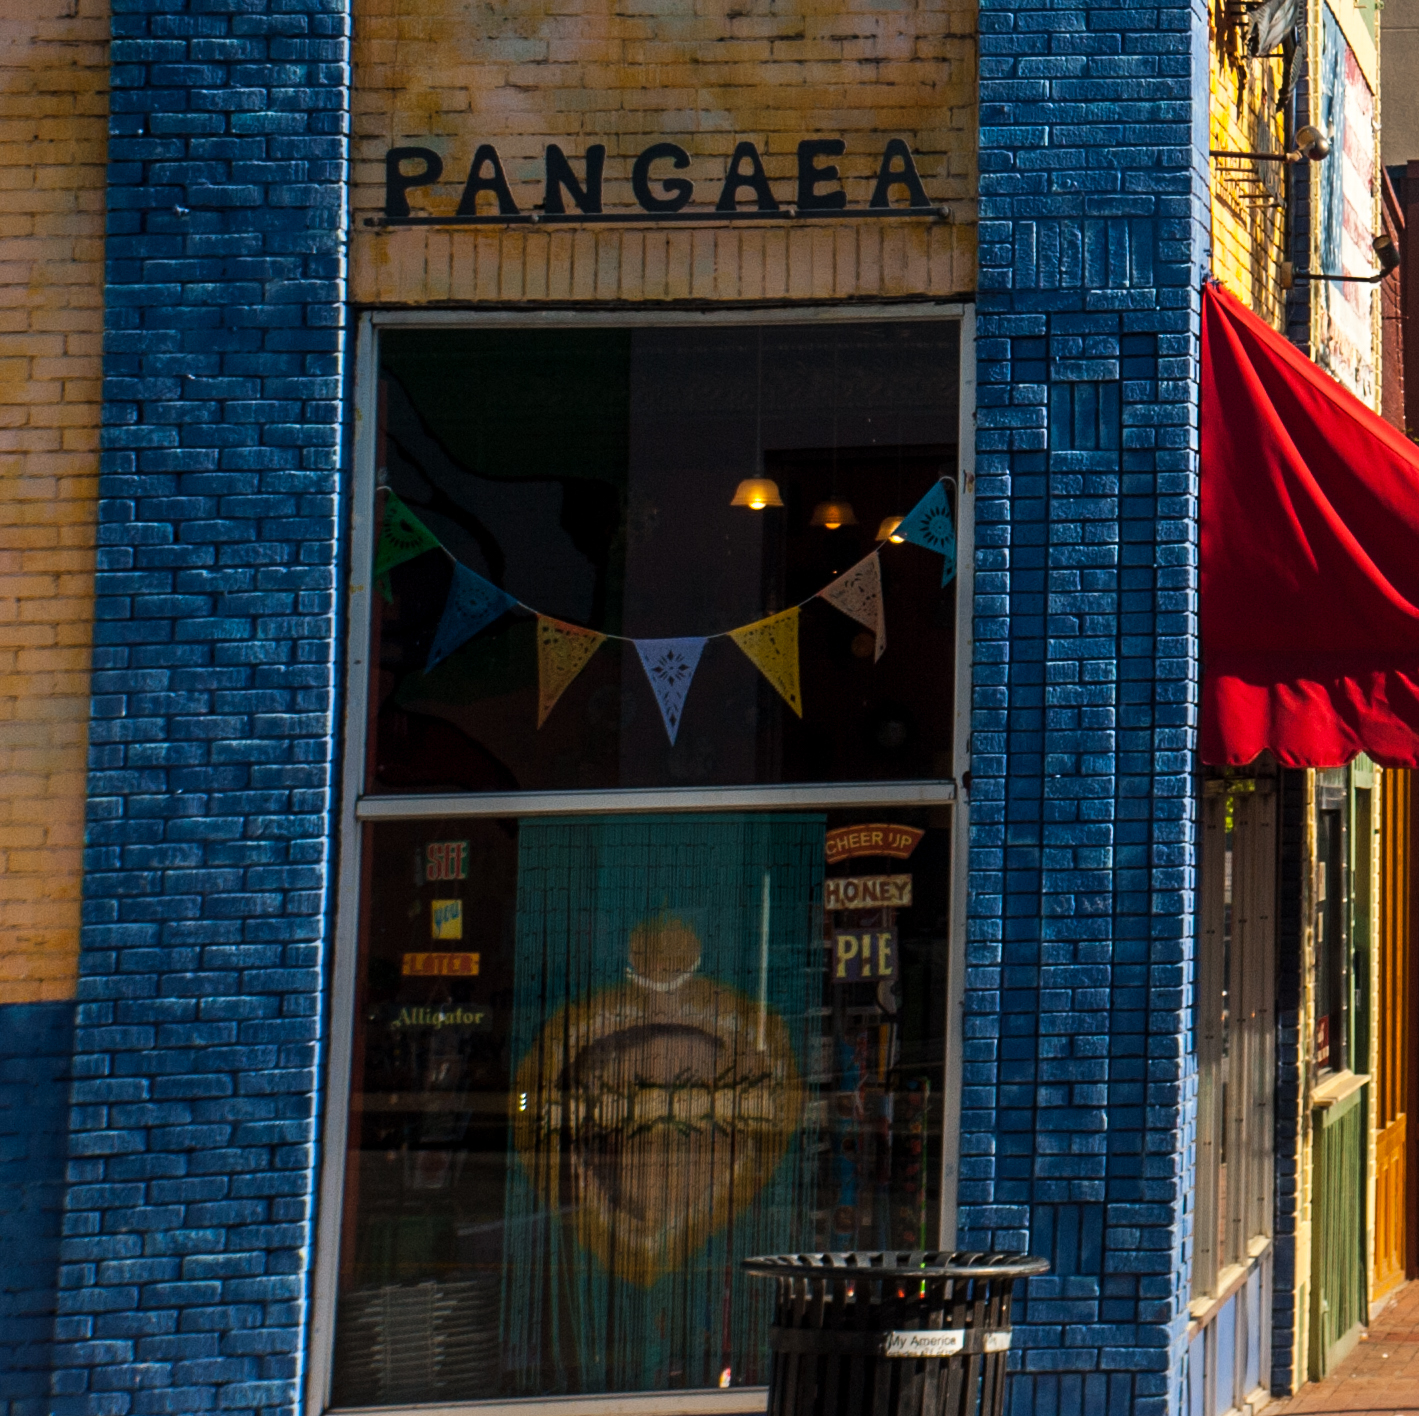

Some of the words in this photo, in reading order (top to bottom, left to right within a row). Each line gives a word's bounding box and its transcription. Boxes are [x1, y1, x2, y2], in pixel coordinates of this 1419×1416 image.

[384, 138, 931, 217] PANGAEA
[826, 831, 883, 855] CHEER
[826, 881, 908, 903] HONEY
[836, 932, 893, 980] PIE
[910, 1334, 957, 1347] America
